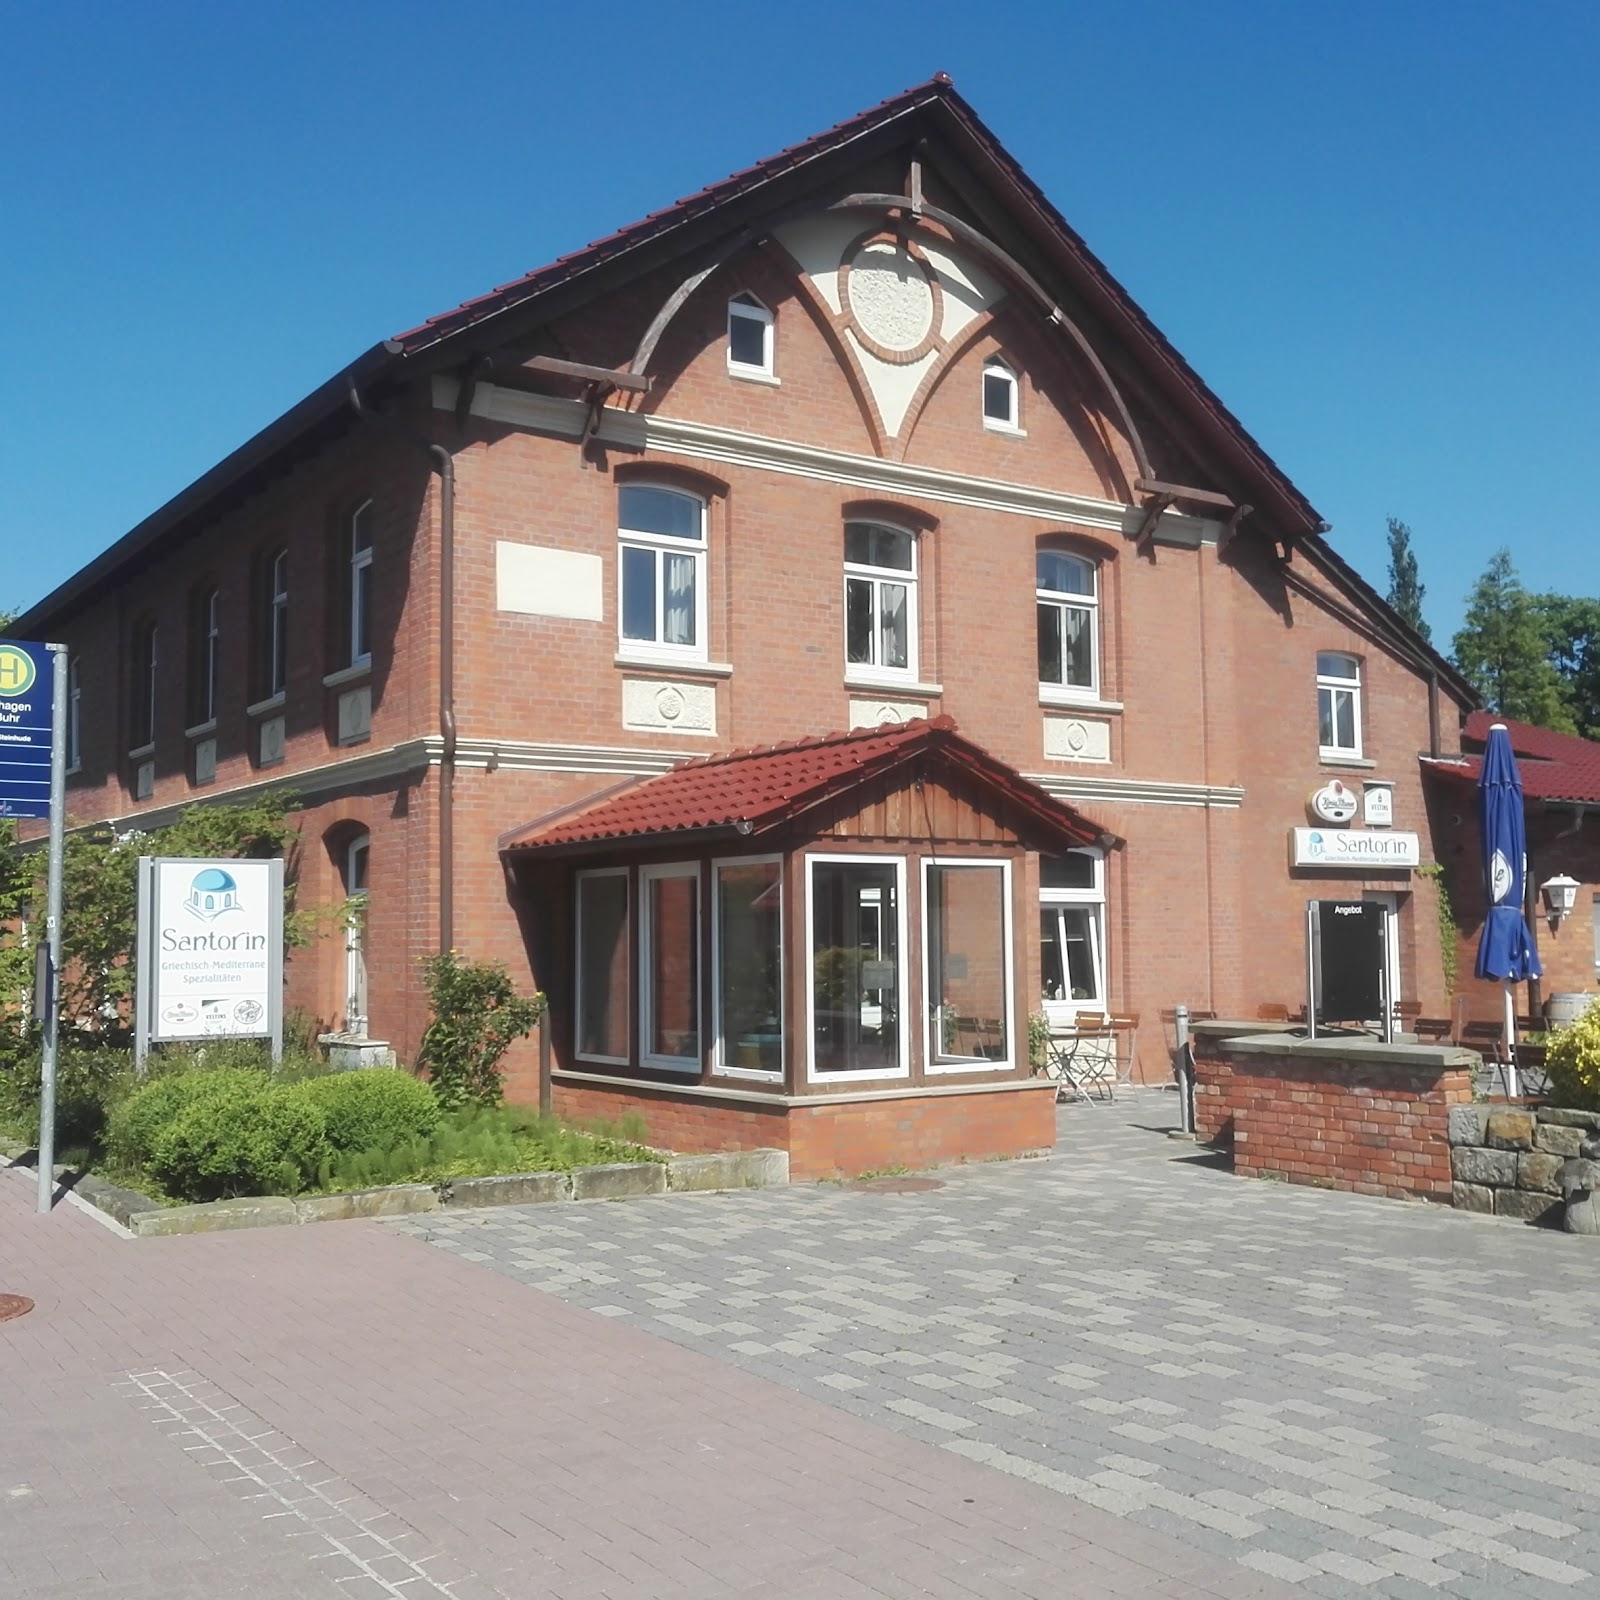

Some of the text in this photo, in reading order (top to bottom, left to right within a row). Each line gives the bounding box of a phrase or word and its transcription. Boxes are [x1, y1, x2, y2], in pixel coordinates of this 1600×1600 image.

[1336, 832, 1408, 854] Santorin
[1334, 905, 1362, 916] Angebot
[162, 928, 266, 952] Santorin
[183, 974, 242, 985] Spezialitäten
